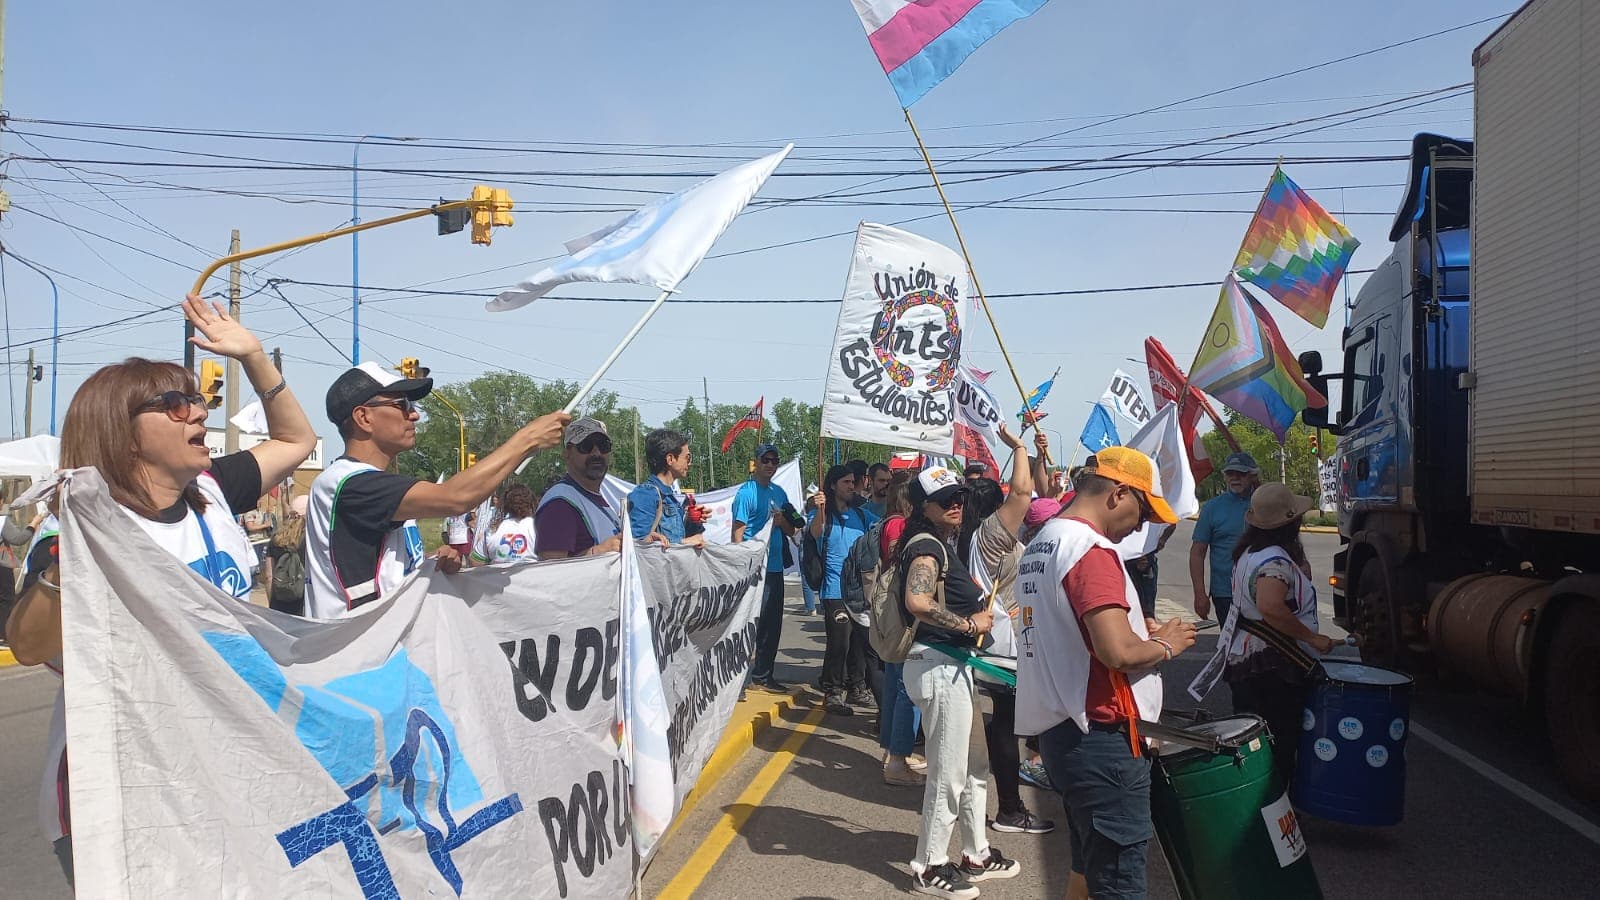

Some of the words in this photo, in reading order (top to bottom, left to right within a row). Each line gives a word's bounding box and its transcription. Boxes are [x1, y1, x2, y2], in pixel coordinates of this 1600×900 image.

[873, 262, 938, 300] Unión
[944, 277, 959, 303] de
[839, 337, 947, 426] Estudiantes
[537, 769, 613, 899] POR
